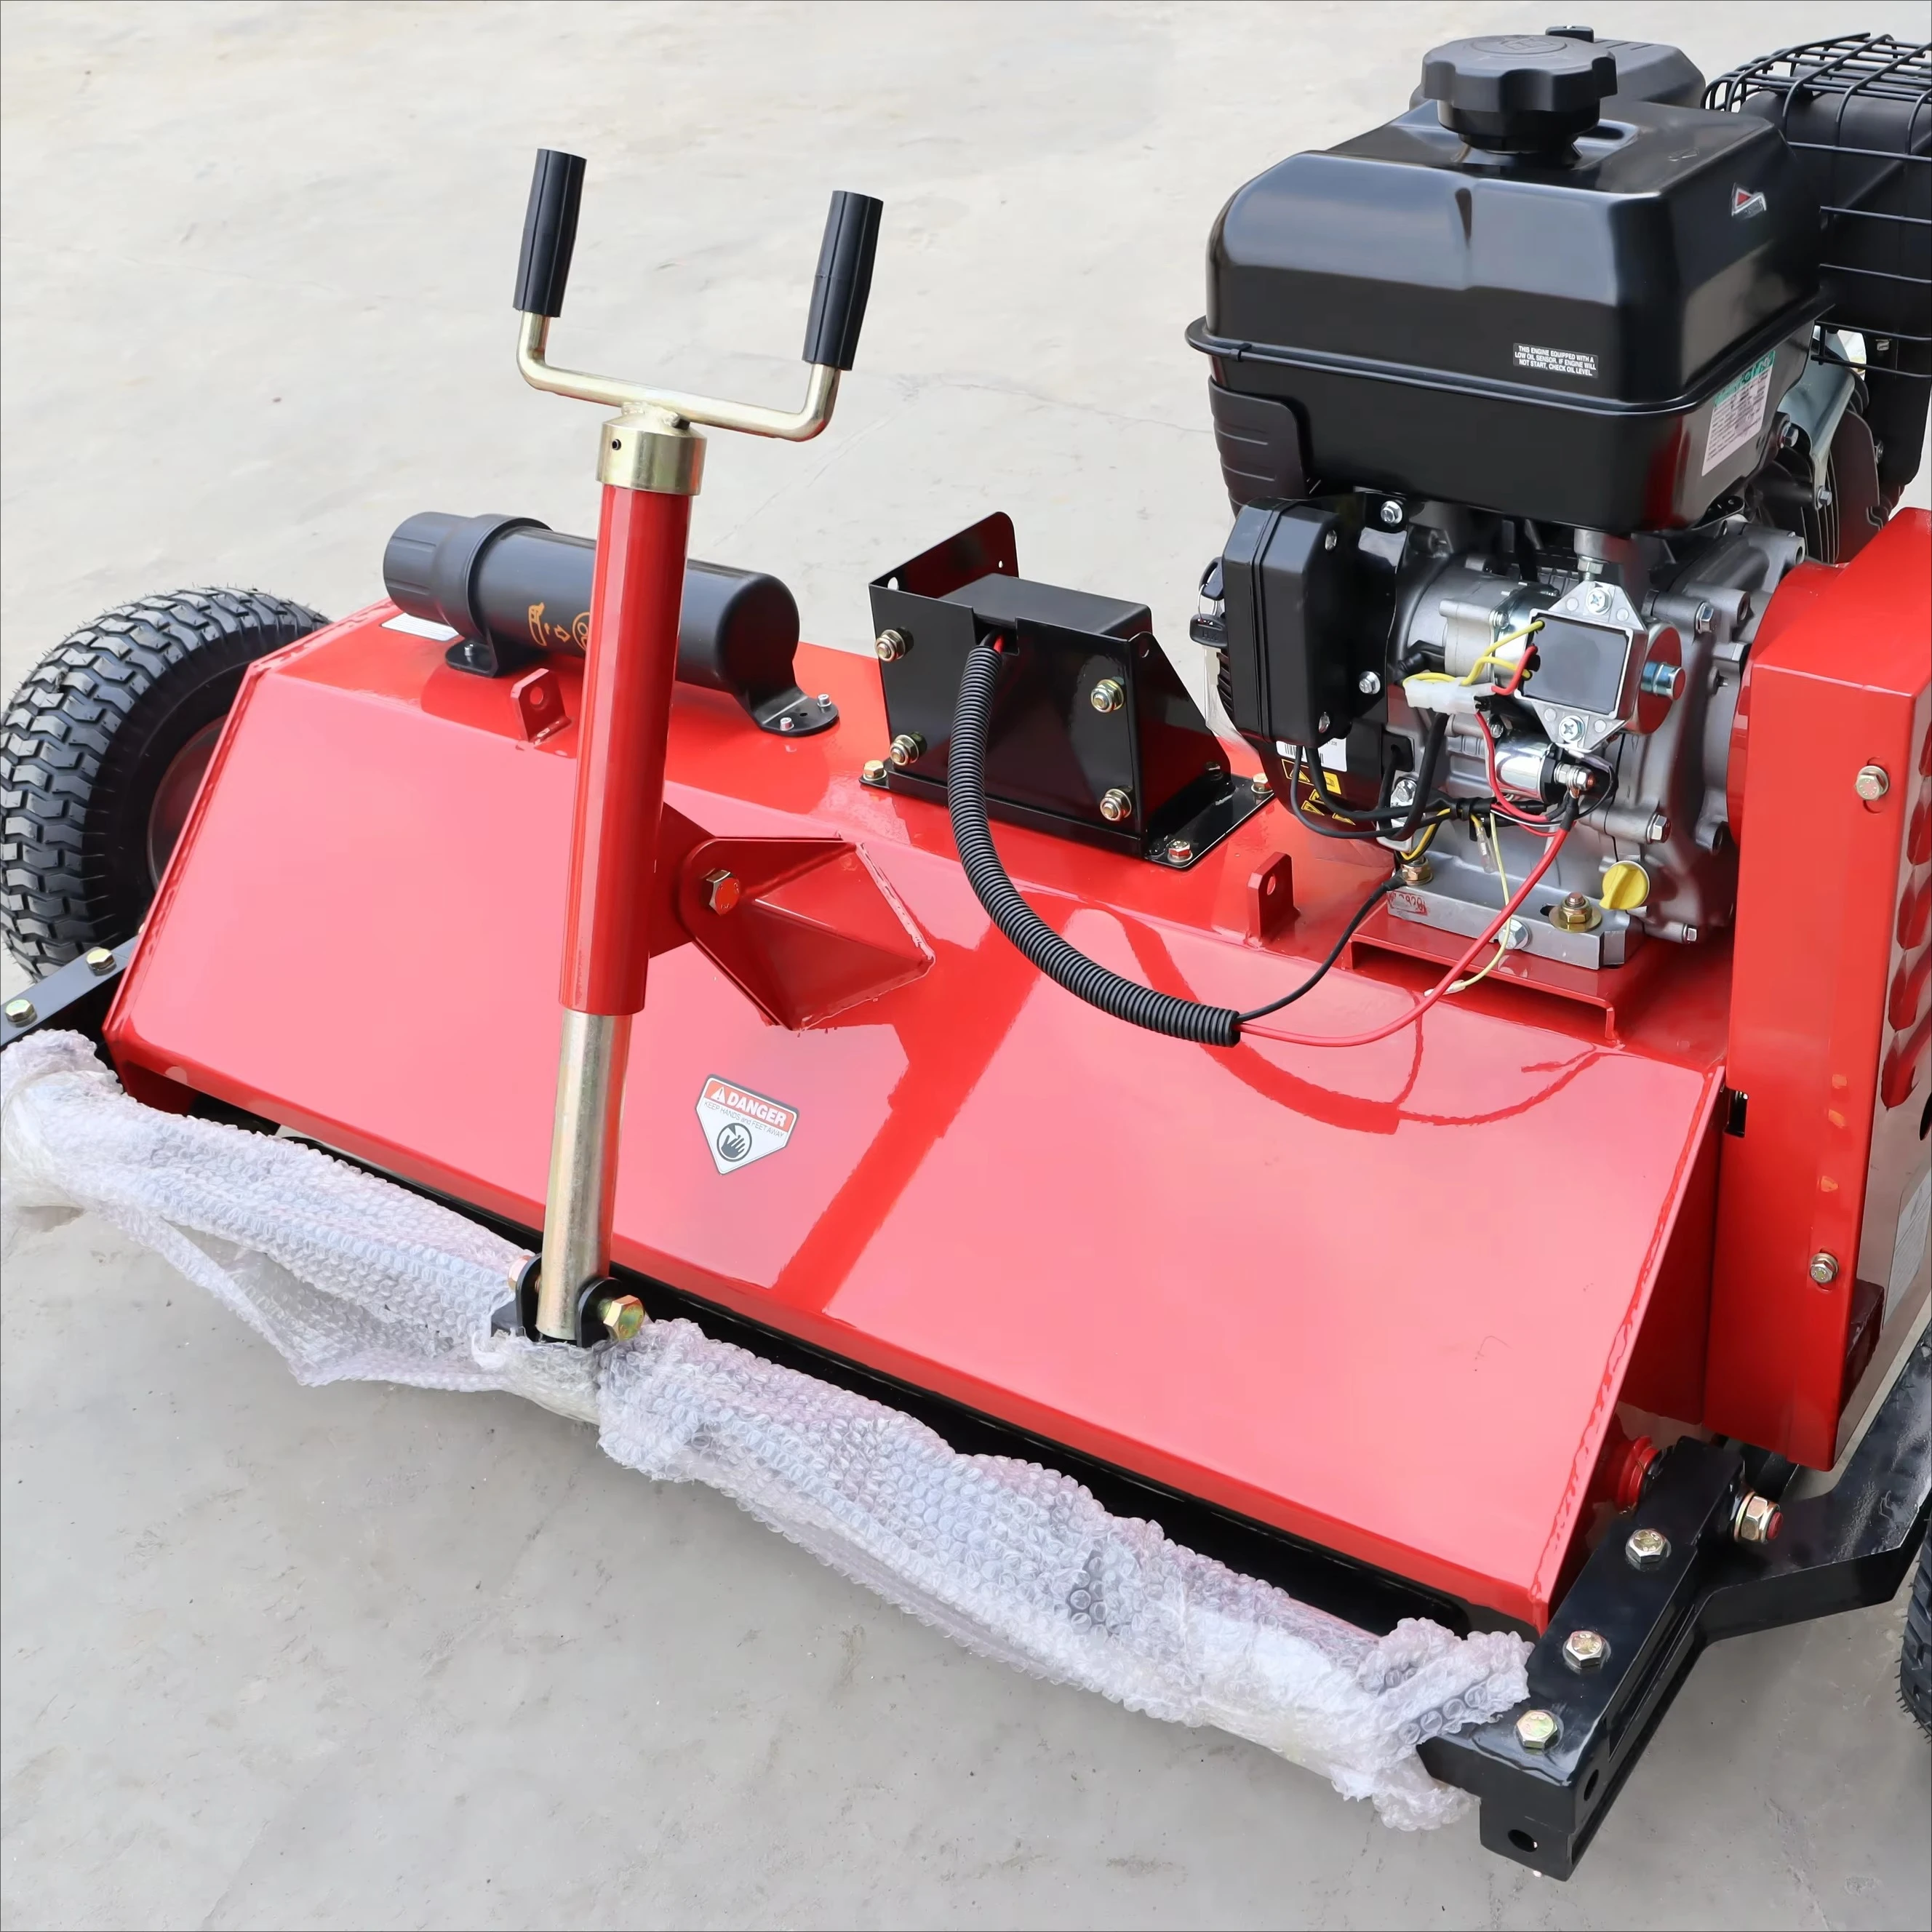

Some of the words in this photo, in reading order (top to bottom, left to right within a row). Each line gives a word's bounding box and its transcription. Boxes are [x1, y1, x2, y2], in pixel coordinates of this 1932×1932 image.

[1518, 346, 1530, 354] THIS
[1530, 347, 1549, 356] ENGINE
[1550, 351, 1575, 360] EQUIPPED
[1576, 354, 1589, 362] WITH
[1527, 353, 1535, 361] OIL
[1565, 359, 1584, 368] ENGINE
[1584, 362, 1596, 370] WILL
[1530, 360, 1548, 370] START,
[1548, 364, 1566, 372] CHECK
[1567, 366, 1576, 374] OIL
[1576, 367, 1593, 376] LEVEL.
[727, 1091, 787, 1127] DANGER
[704, 1101, 720, 1110] KEEP
[721, 1107, 741, 1120] HANDS
[741, 1117, 751, 1125] and
[751, 1120, 766, 1131] FEET
[767, 1127, 785, 1138] AWAY
